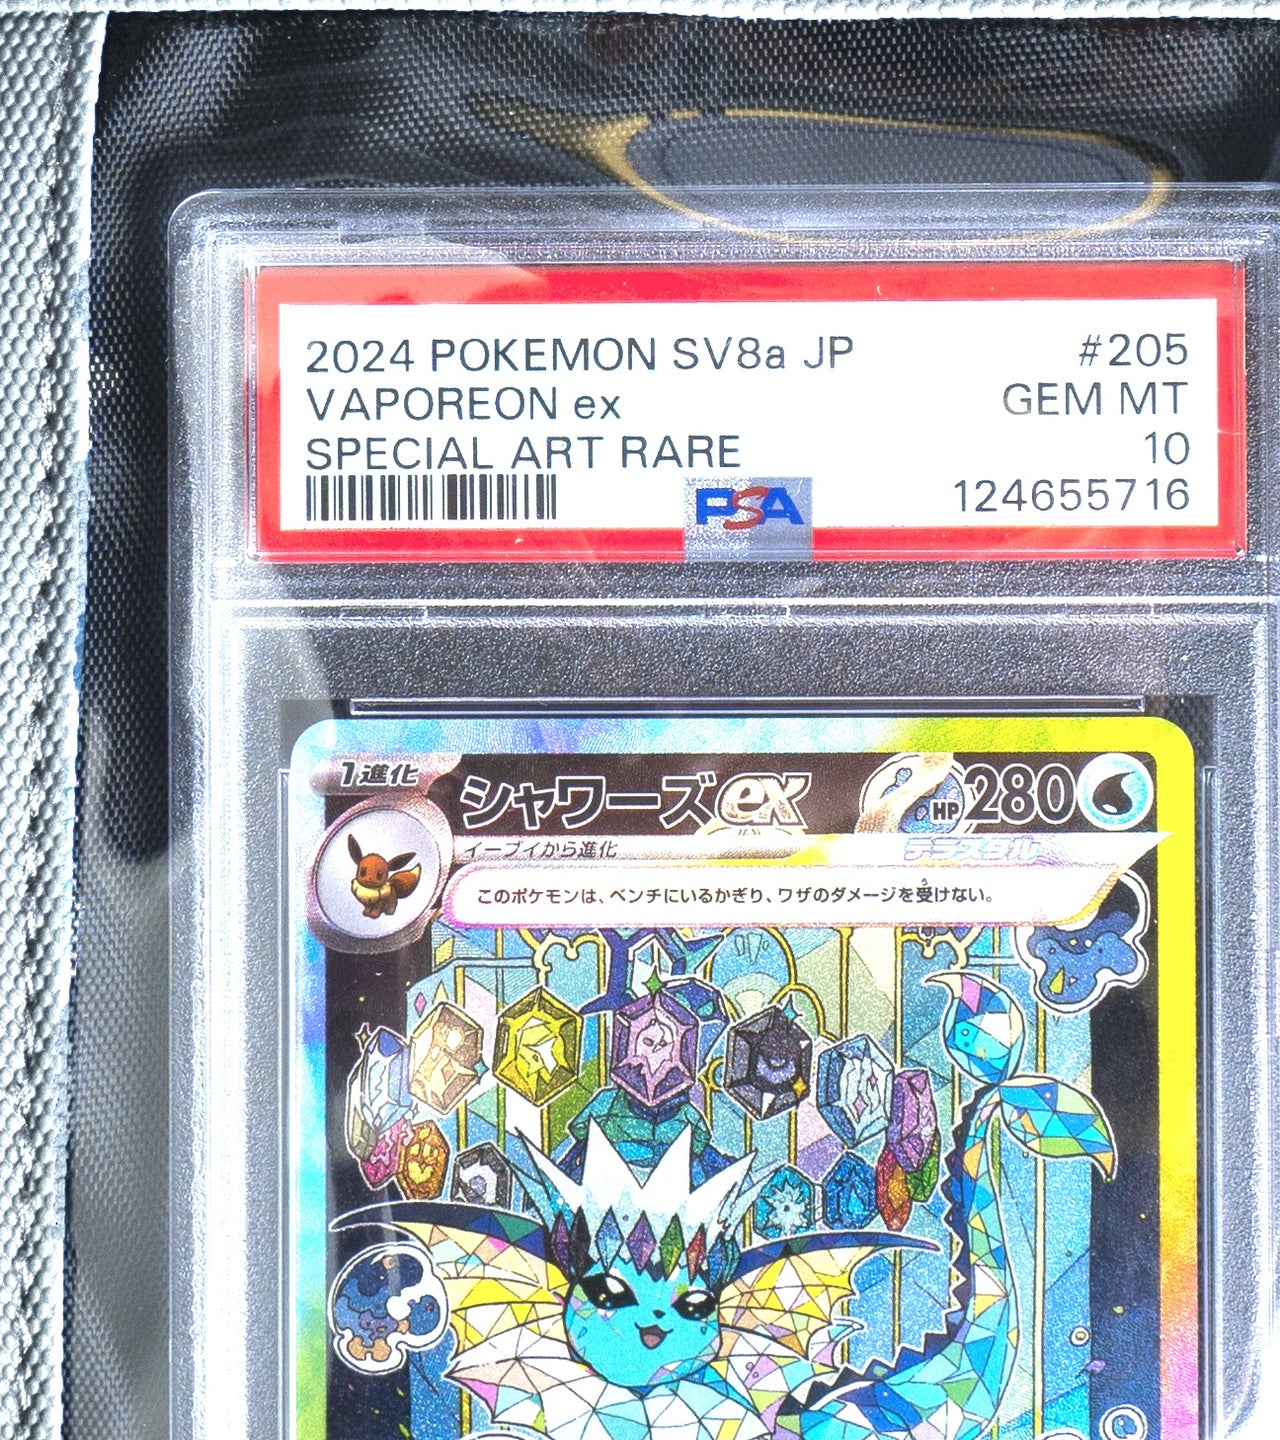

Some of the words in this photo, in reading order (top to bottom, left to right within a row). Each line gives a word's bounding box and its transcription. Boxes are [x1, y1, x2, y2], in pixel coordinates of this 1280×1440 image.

[305, 338, 415, 374] 2024
[431, 336, 656, 372] POKEMON
[672, 335, 786, 371] SV8a
[803, 335, 854, 370] JP
[1078, 332, 1189, 367] #205
[306, 386, 557, 421] VAPOREON
[573, 394, 622, 420] ex
[1002, 381, 1103, 416] GEM
[1119, 380, 1190, 415] MT
[305, 436, 494, 470] SPECIAL
[510, 435, 605, 470] ART
[620, 434, 741, 469] RARE
[1143, 430, 1191, 465] 10
[694, 485, 806, 530] PSA
[953, 477, 1191, 513] 124655716
[340, 761, 420, 786] 1進化
[929, 798, 961, 824] HP
[962, 762, 1078, 825] 280
[463, 840, 619, 860] イーブイから進化
